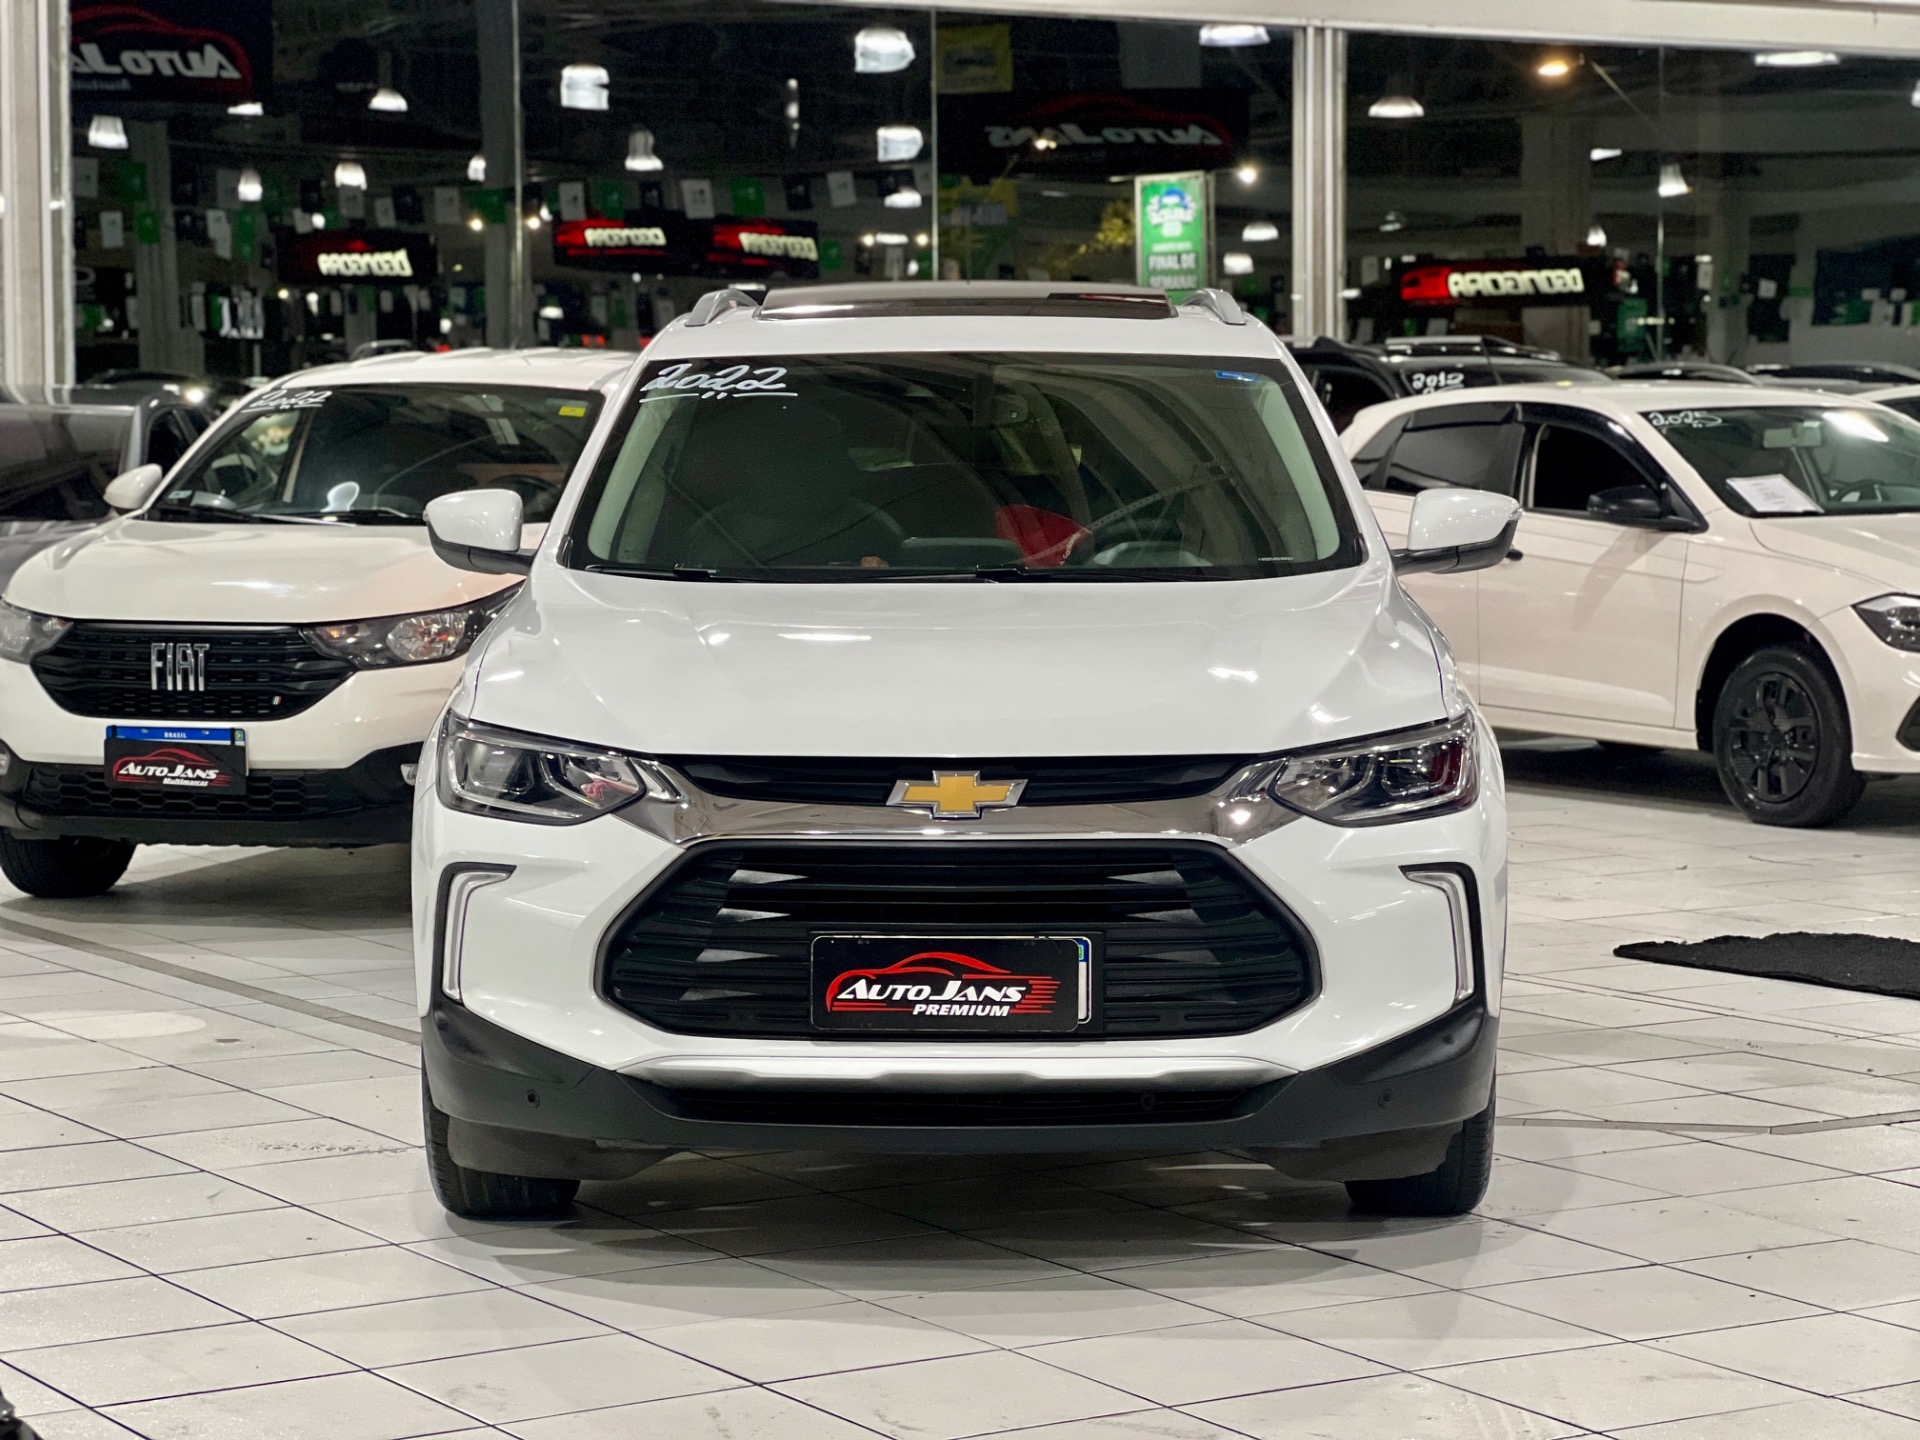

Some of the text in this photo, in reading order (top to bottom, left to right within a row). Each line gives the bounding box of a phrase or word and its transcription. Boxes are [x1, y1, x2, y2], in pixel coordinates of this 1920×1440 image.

[640, 363, 787, 391] 2022
[151, 642, 211, 691] FIAT
[163, 778, 208, 787] Multimarcas
[912, 1004, 1010, 1016] PREMIUM
